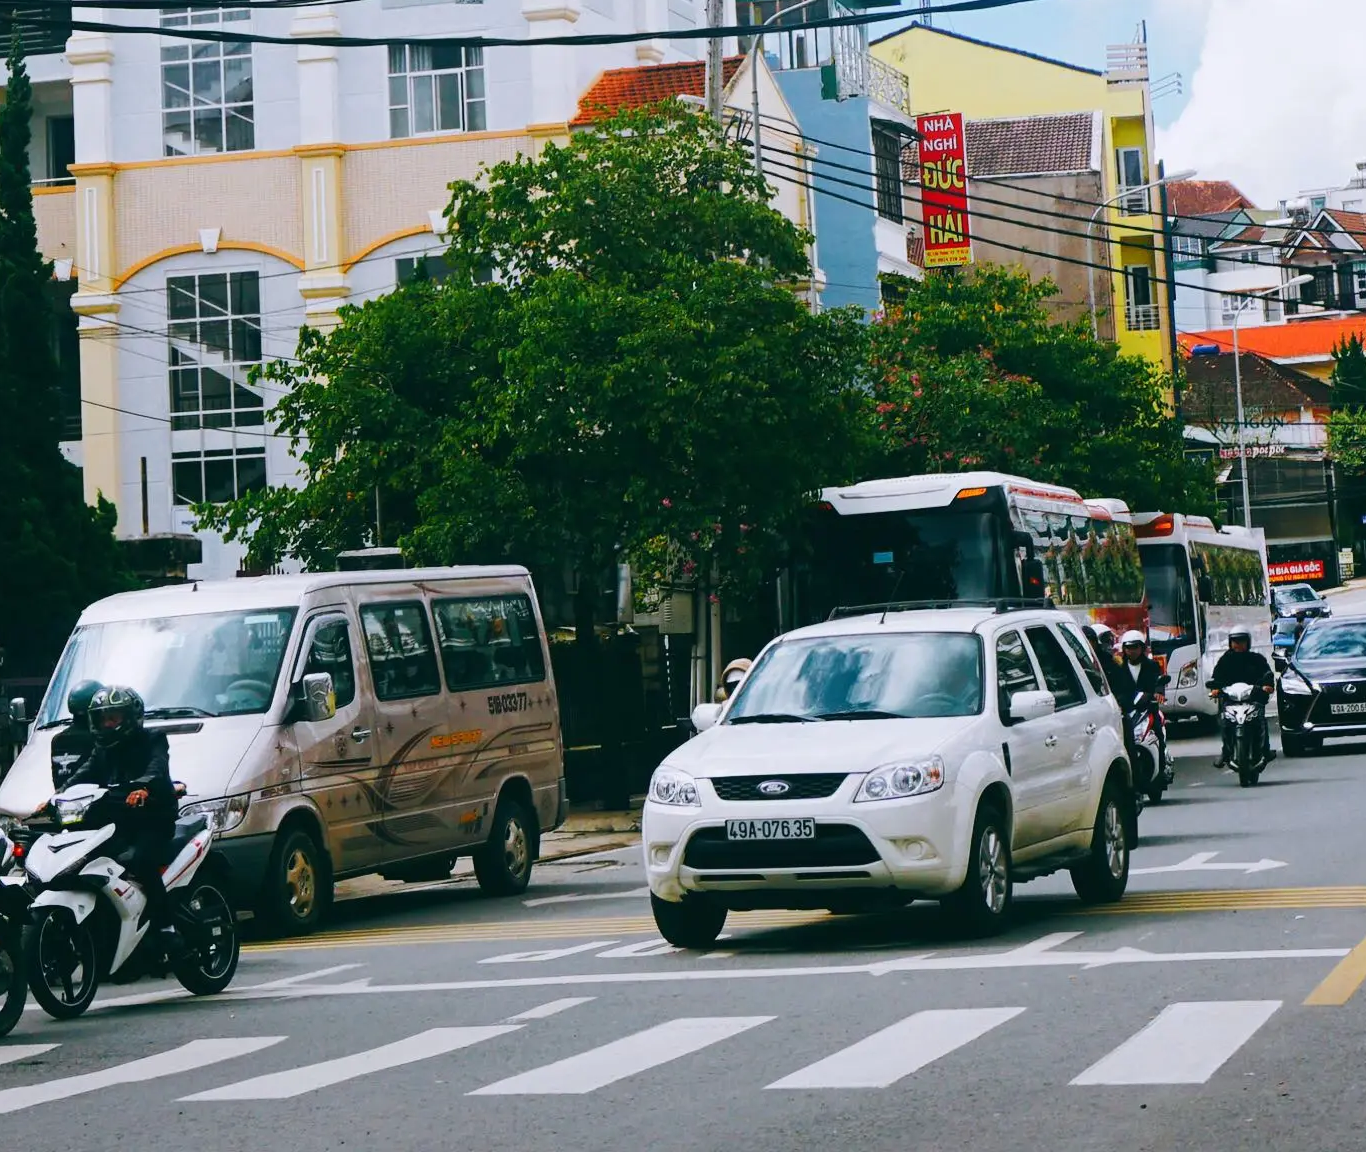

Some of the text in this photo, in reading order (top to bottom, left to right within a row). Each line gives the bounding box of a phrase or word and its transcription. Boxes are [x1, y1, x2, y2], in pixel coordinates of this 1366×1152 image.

[924, 116, 954, 132] NHÀ
[923, 154, 964, 189] ĐỨC
[930, 205, 964, 244] HẢI
[1276, 566, 1289, 575] BIA
[1304, 561, 1321, 573] GỐC
[729, 819, 813, 839] 49A-076.35
